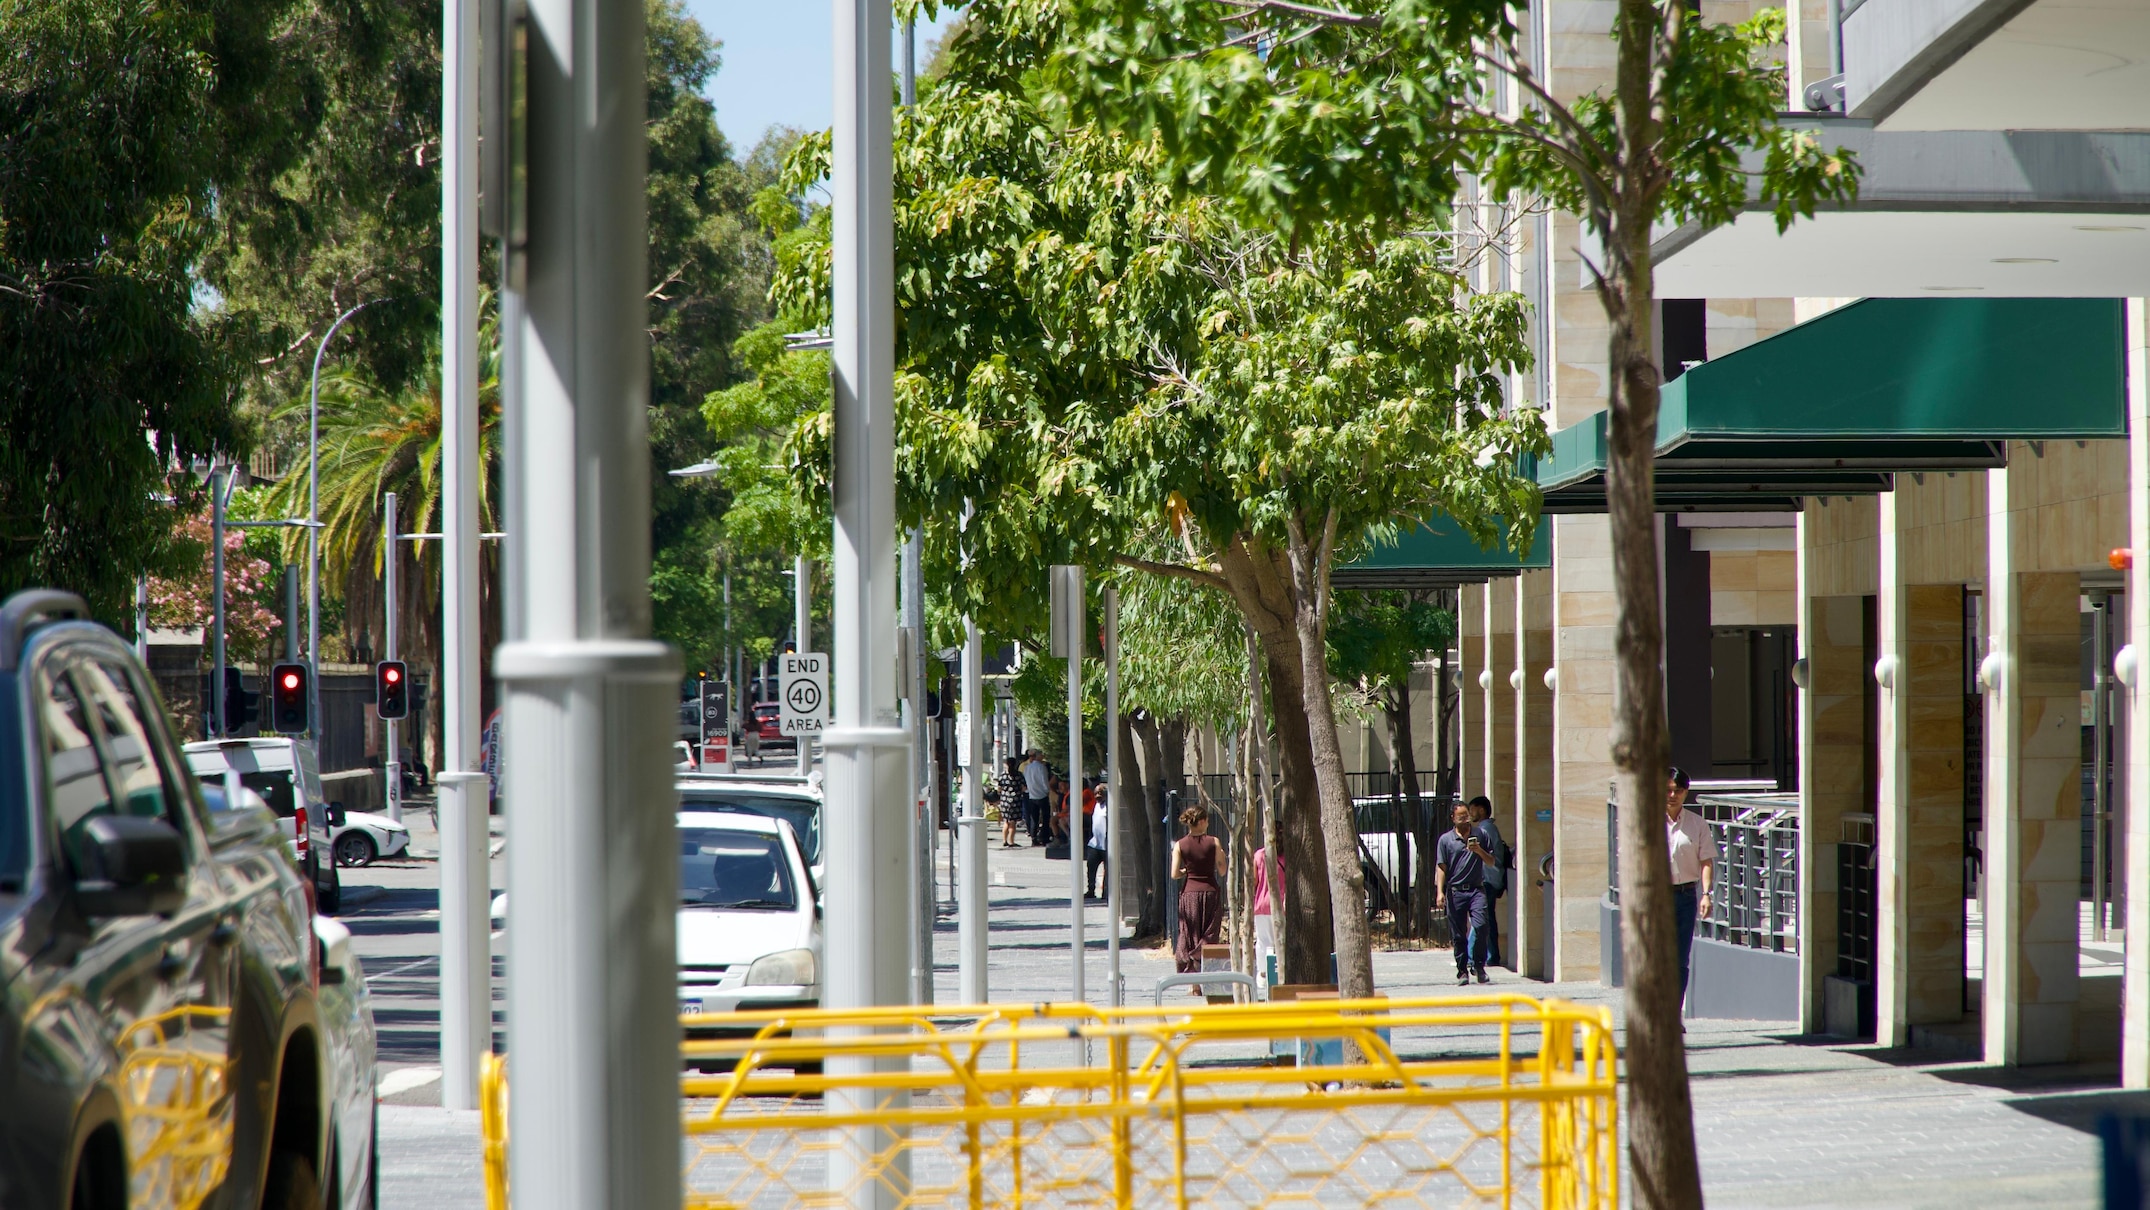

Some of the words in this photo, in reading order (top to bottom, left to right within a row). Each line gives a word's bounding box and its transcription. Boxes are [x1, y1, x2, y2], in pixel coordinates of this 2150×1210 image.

[787, 659, 819, 673] END
[791, 688, 816, 704] 40
[786, 718, 823, 731] AREA
